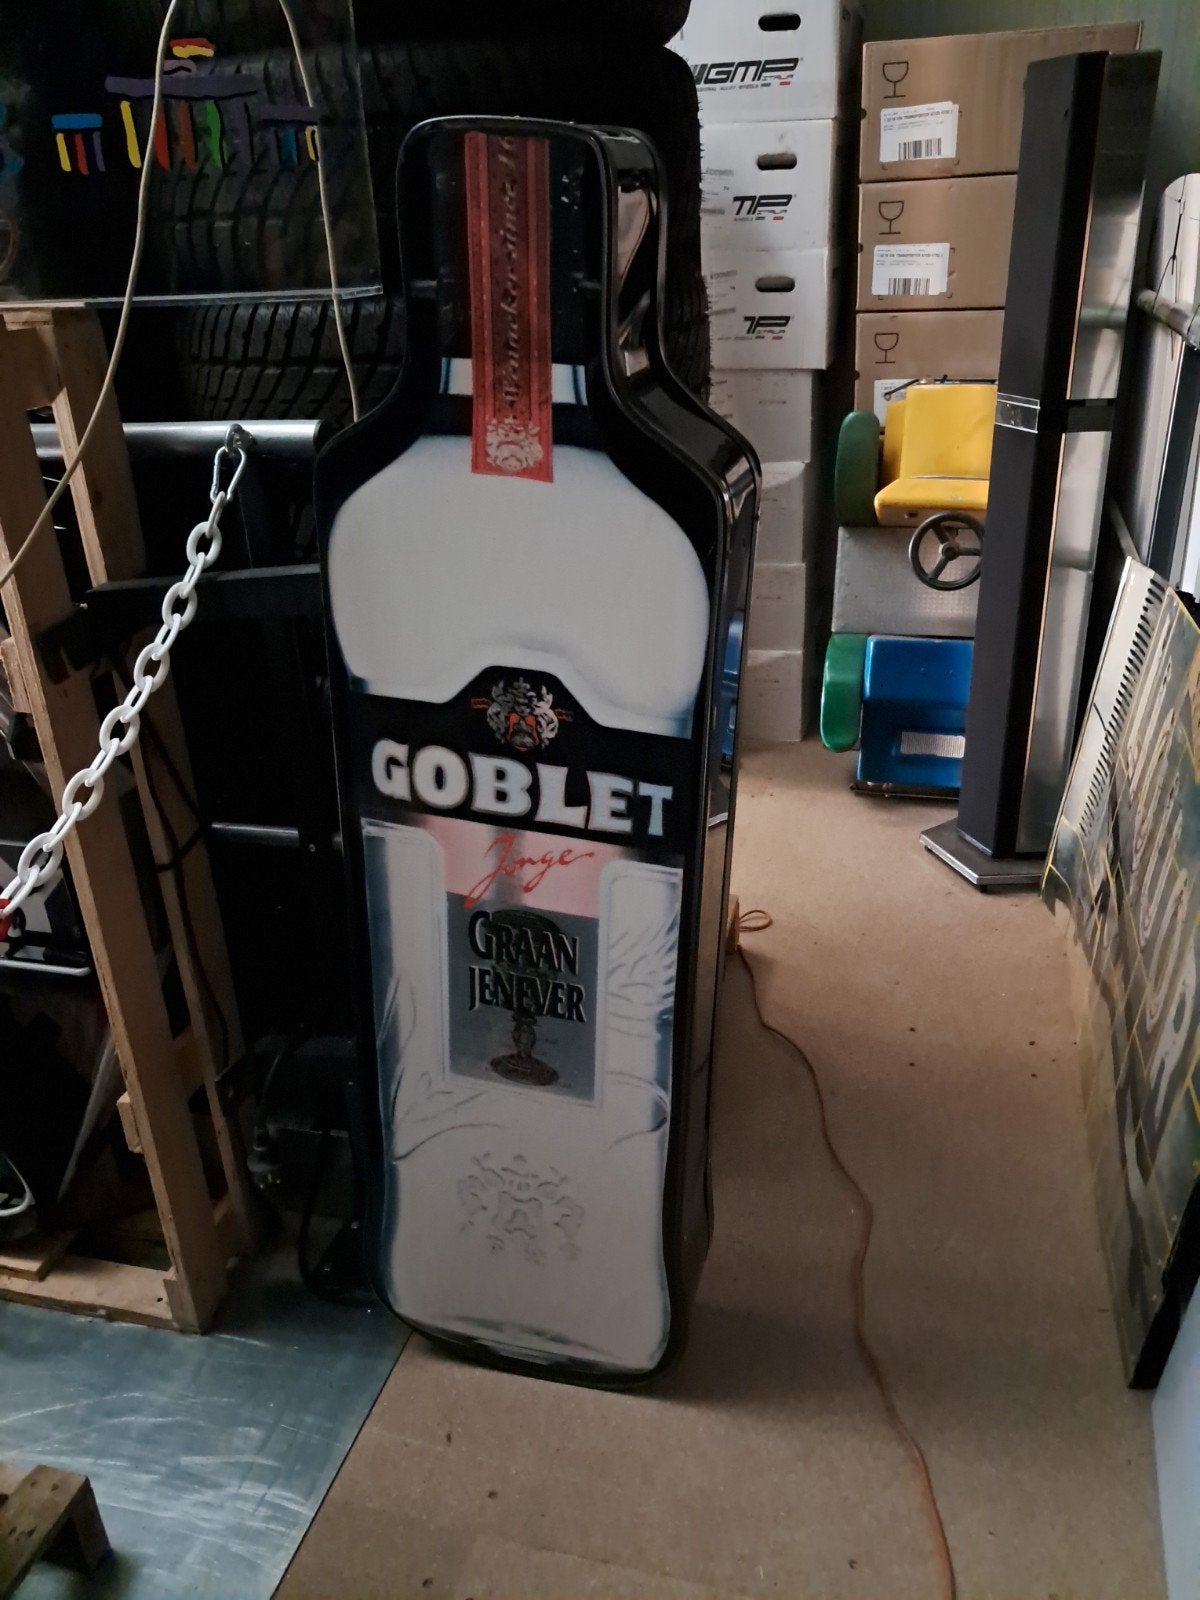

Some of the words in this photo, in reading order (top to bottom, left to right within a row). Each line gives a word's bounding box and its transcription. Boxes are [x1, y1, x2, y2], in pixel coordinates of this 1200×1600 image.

[372, 738, 673, 837] GOBLET
[464, 834, 595, 909] Jonge
[468, 911, 580, 976] GRAAN
[468, 965, 587, 1023] JENEVER
